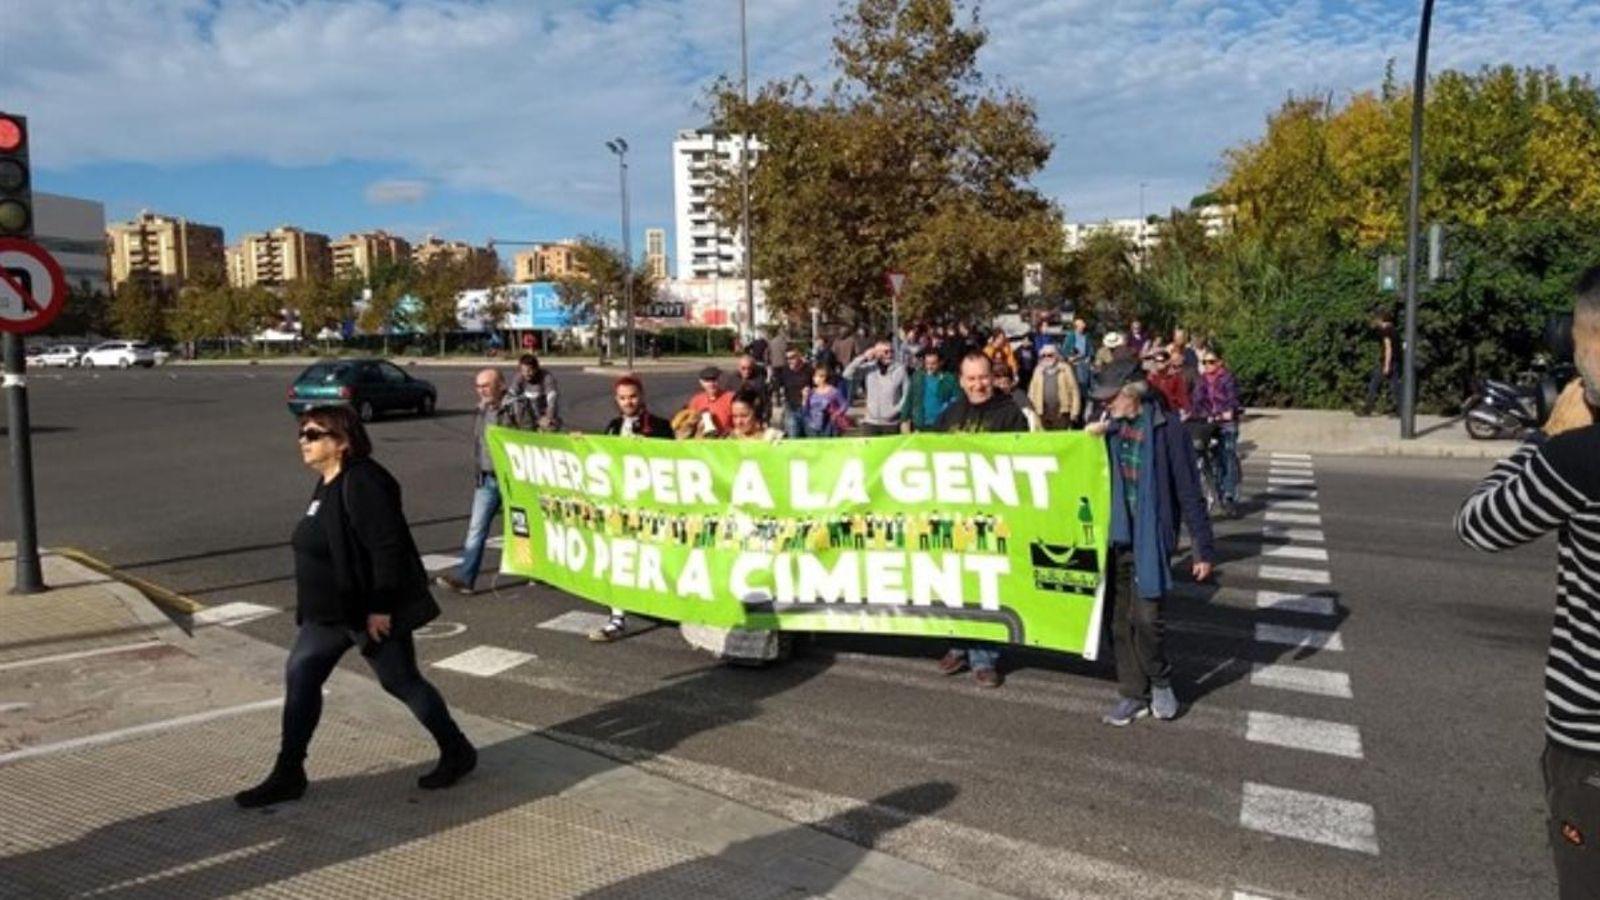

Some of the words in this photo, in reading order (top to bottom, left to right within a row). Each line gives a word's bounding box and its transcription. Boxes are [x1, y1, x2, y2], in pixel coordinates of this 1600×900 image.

[504, 444, 611, 496] DINERS
[622, 457, 717, 504] PER
[732, 462, 773, 509] A
[790, 459, 868, 509] LA
[881, 451, 1057, 509] GENT
[545, 524, 587, 572] NO
[593, 534, 667, 592] PER
[677, 551, 714, 601] A
[730, 554, 1009, 610] CIMENT
